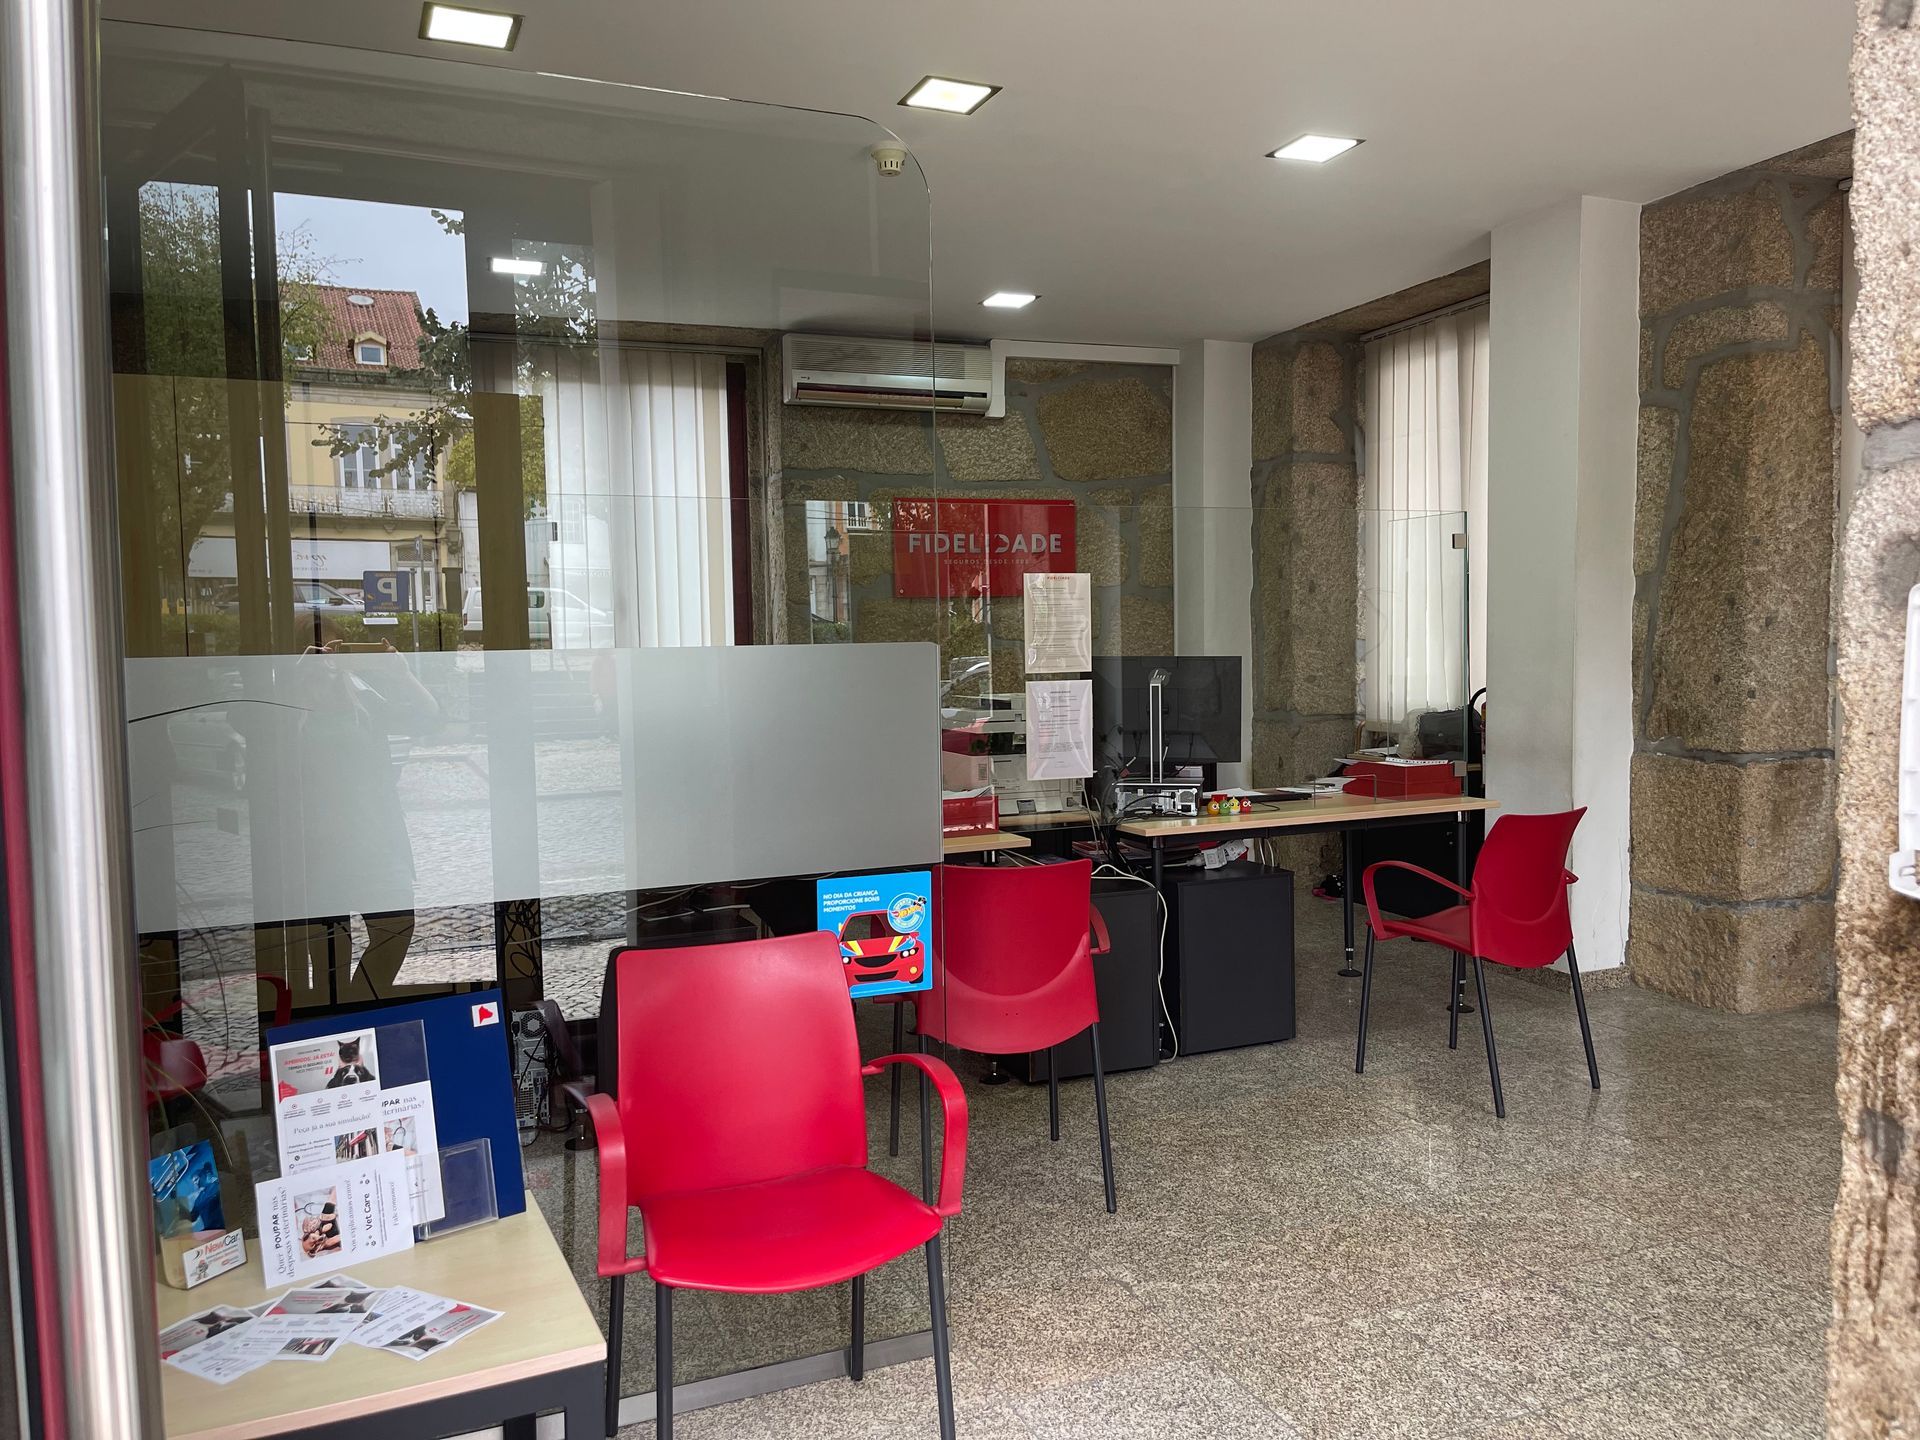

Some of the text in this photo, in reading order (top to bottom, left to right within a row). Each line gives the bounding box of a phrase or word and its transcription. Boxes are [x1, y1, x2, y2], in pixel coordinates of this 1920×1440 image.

[823, 897, 863, 906] PROPORCIONE
[363, 1192, 373, 1232] Vet Care
[271, 1213, 282, 1250] POUPAR
[276, 1253, 287, 1275] Quer
